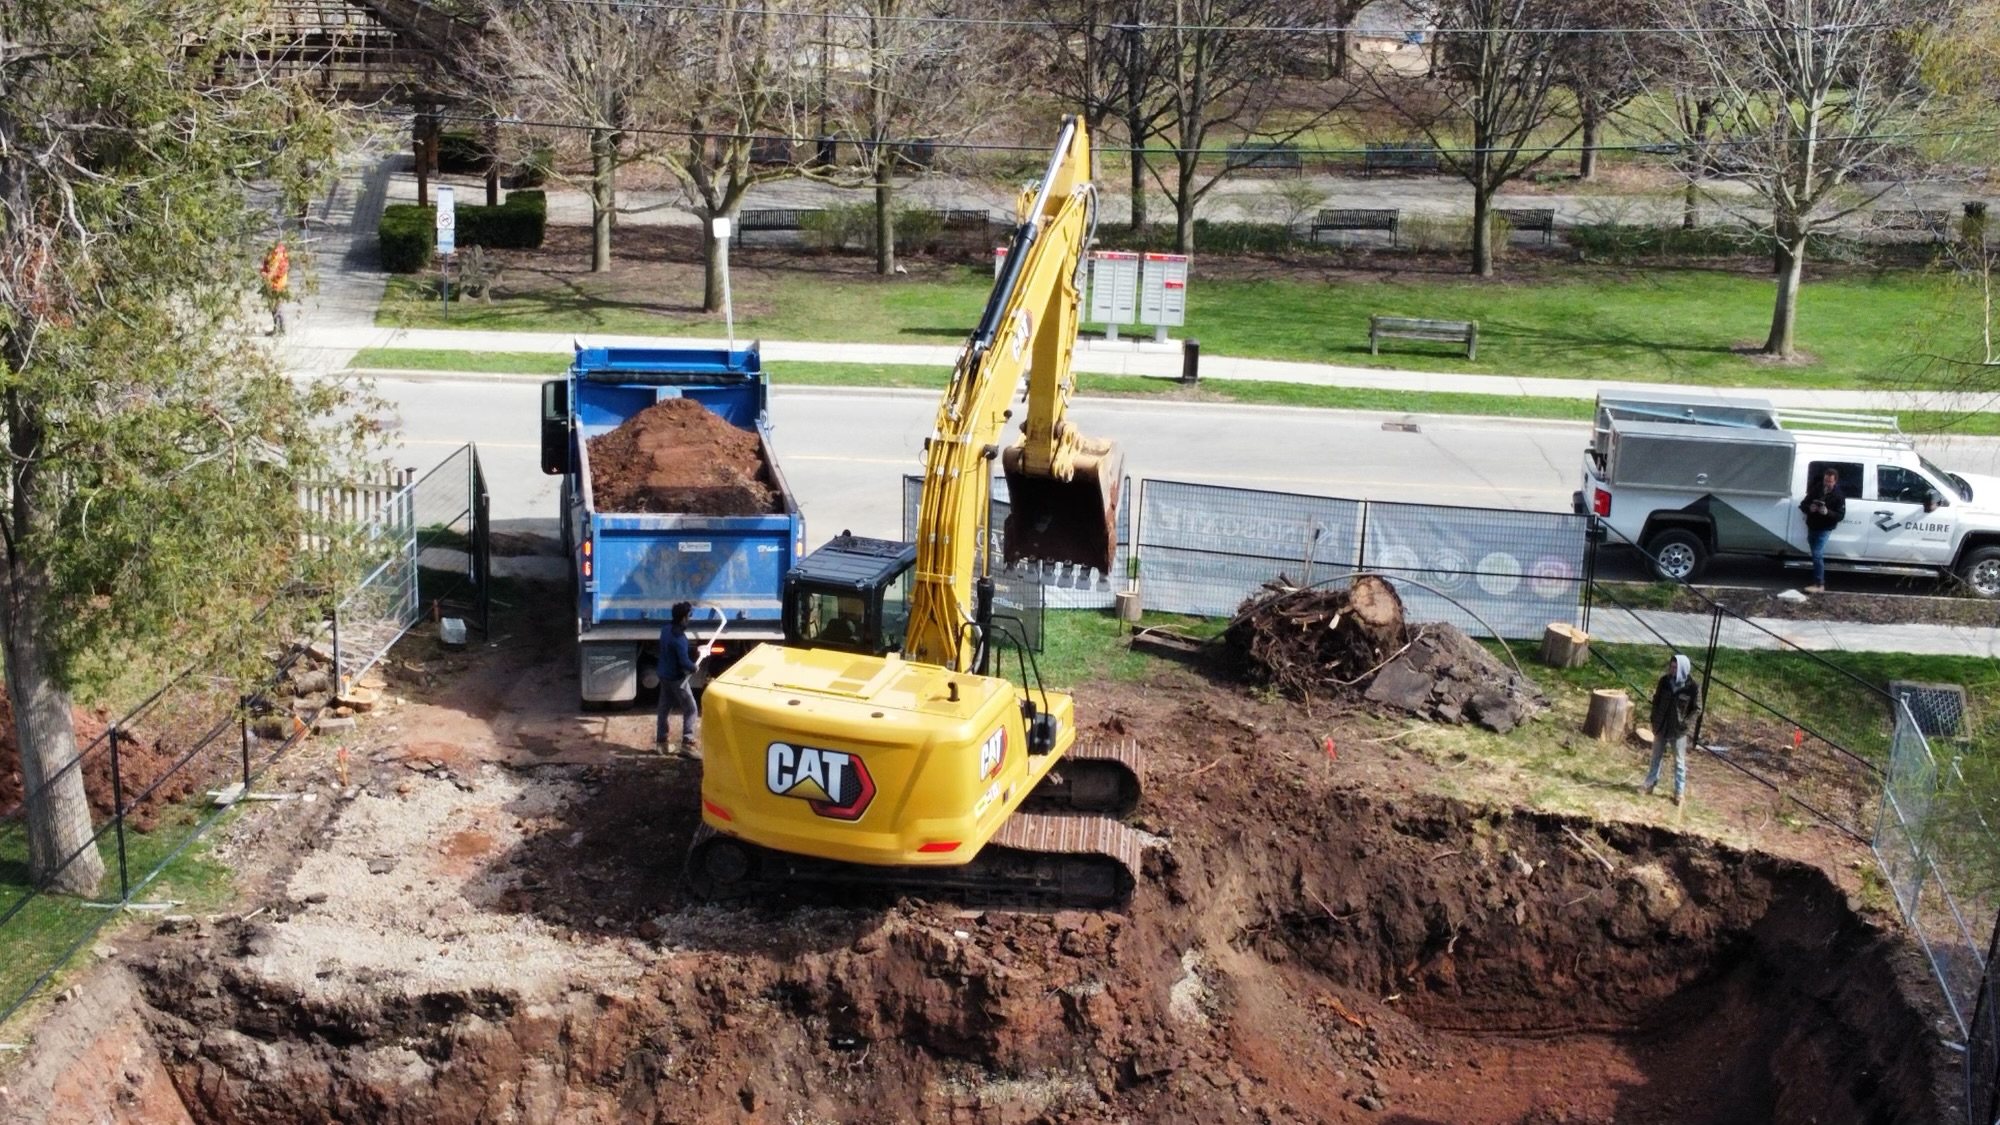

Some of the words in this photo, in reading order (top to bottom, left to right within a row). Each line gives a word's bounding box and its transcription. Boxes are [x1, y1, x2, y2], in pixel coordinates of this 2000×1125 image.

[1905, 521, 1950, 533] CALIBRE
[767, 742, 849, 803] CAT
[980, 731, 1003, 780] CAT
